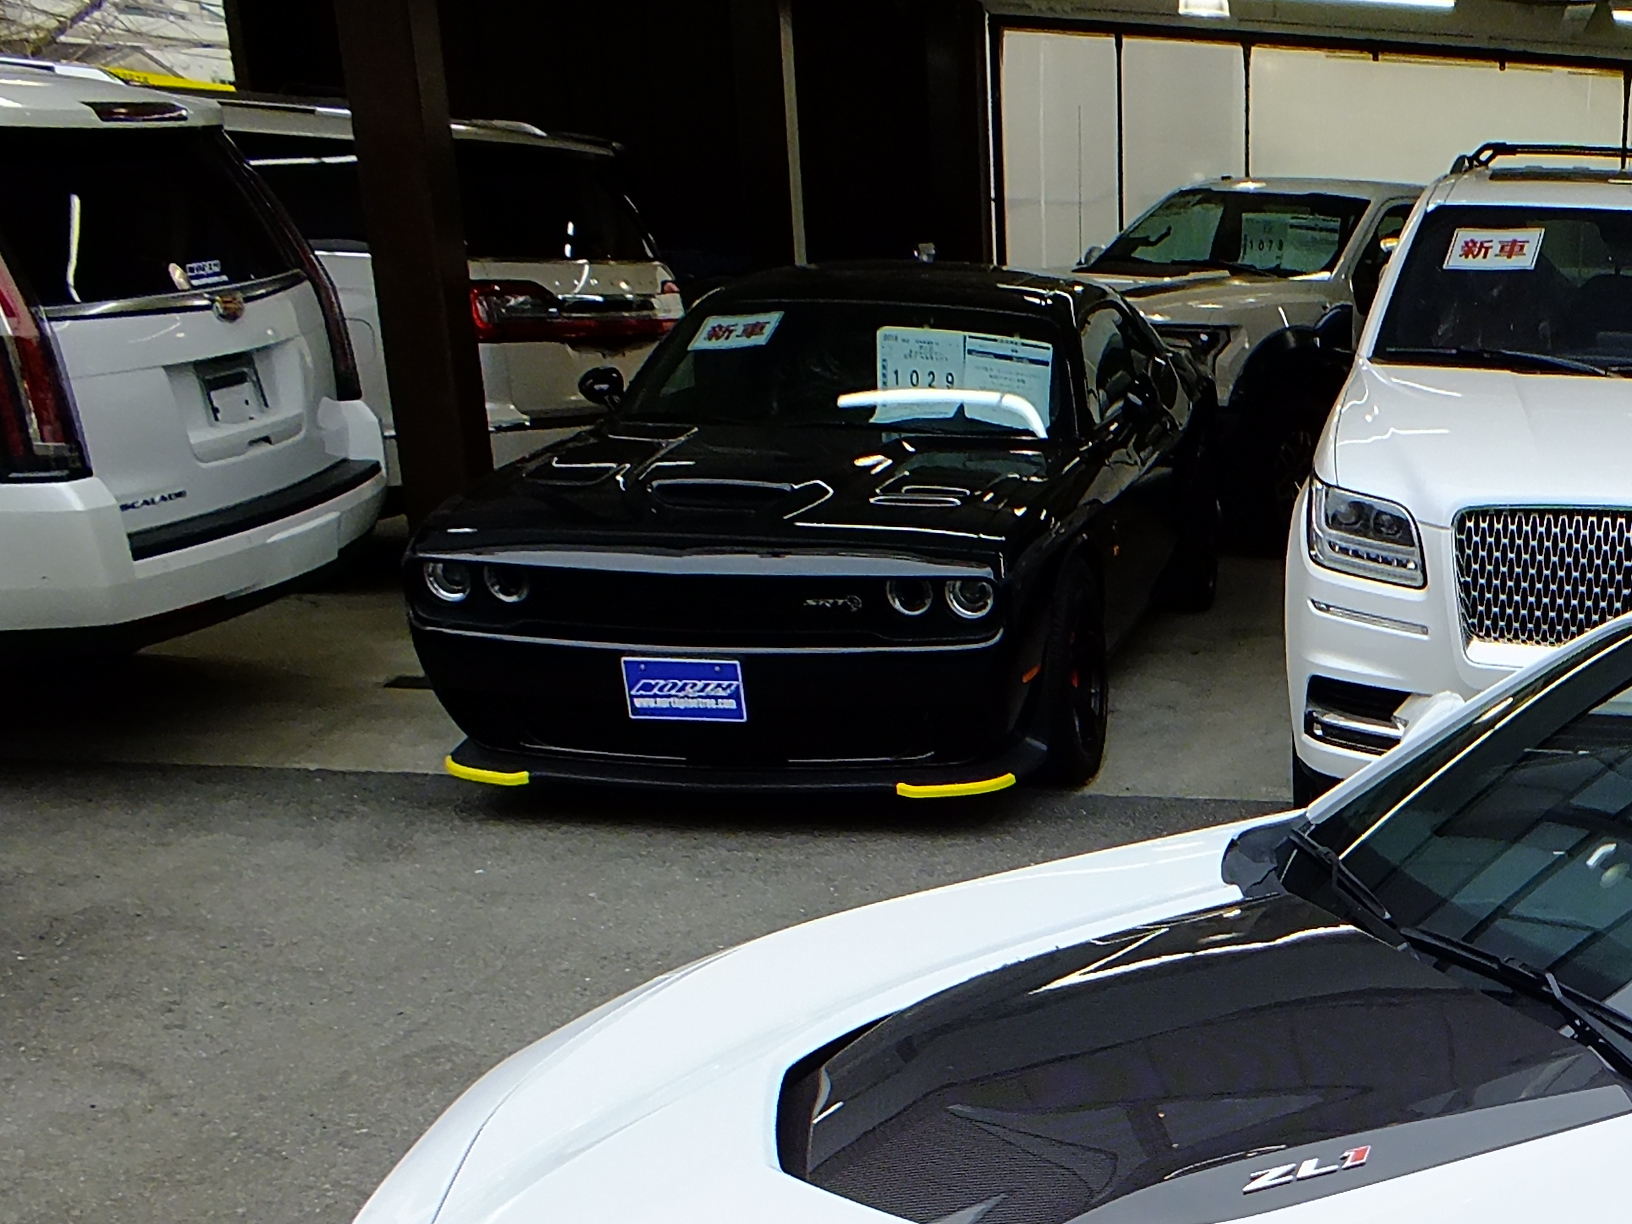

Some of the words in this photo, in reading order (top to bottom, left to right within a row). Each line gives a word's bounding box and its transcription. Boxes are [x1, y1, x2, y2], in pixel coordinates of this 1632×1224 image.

[1459, 238, 1530, 259] 新車
[703, 322, 771, 341] 新車
[893, 369, 955, 389] 1029
[1242, 1145, 1372, 1195] ZL1
